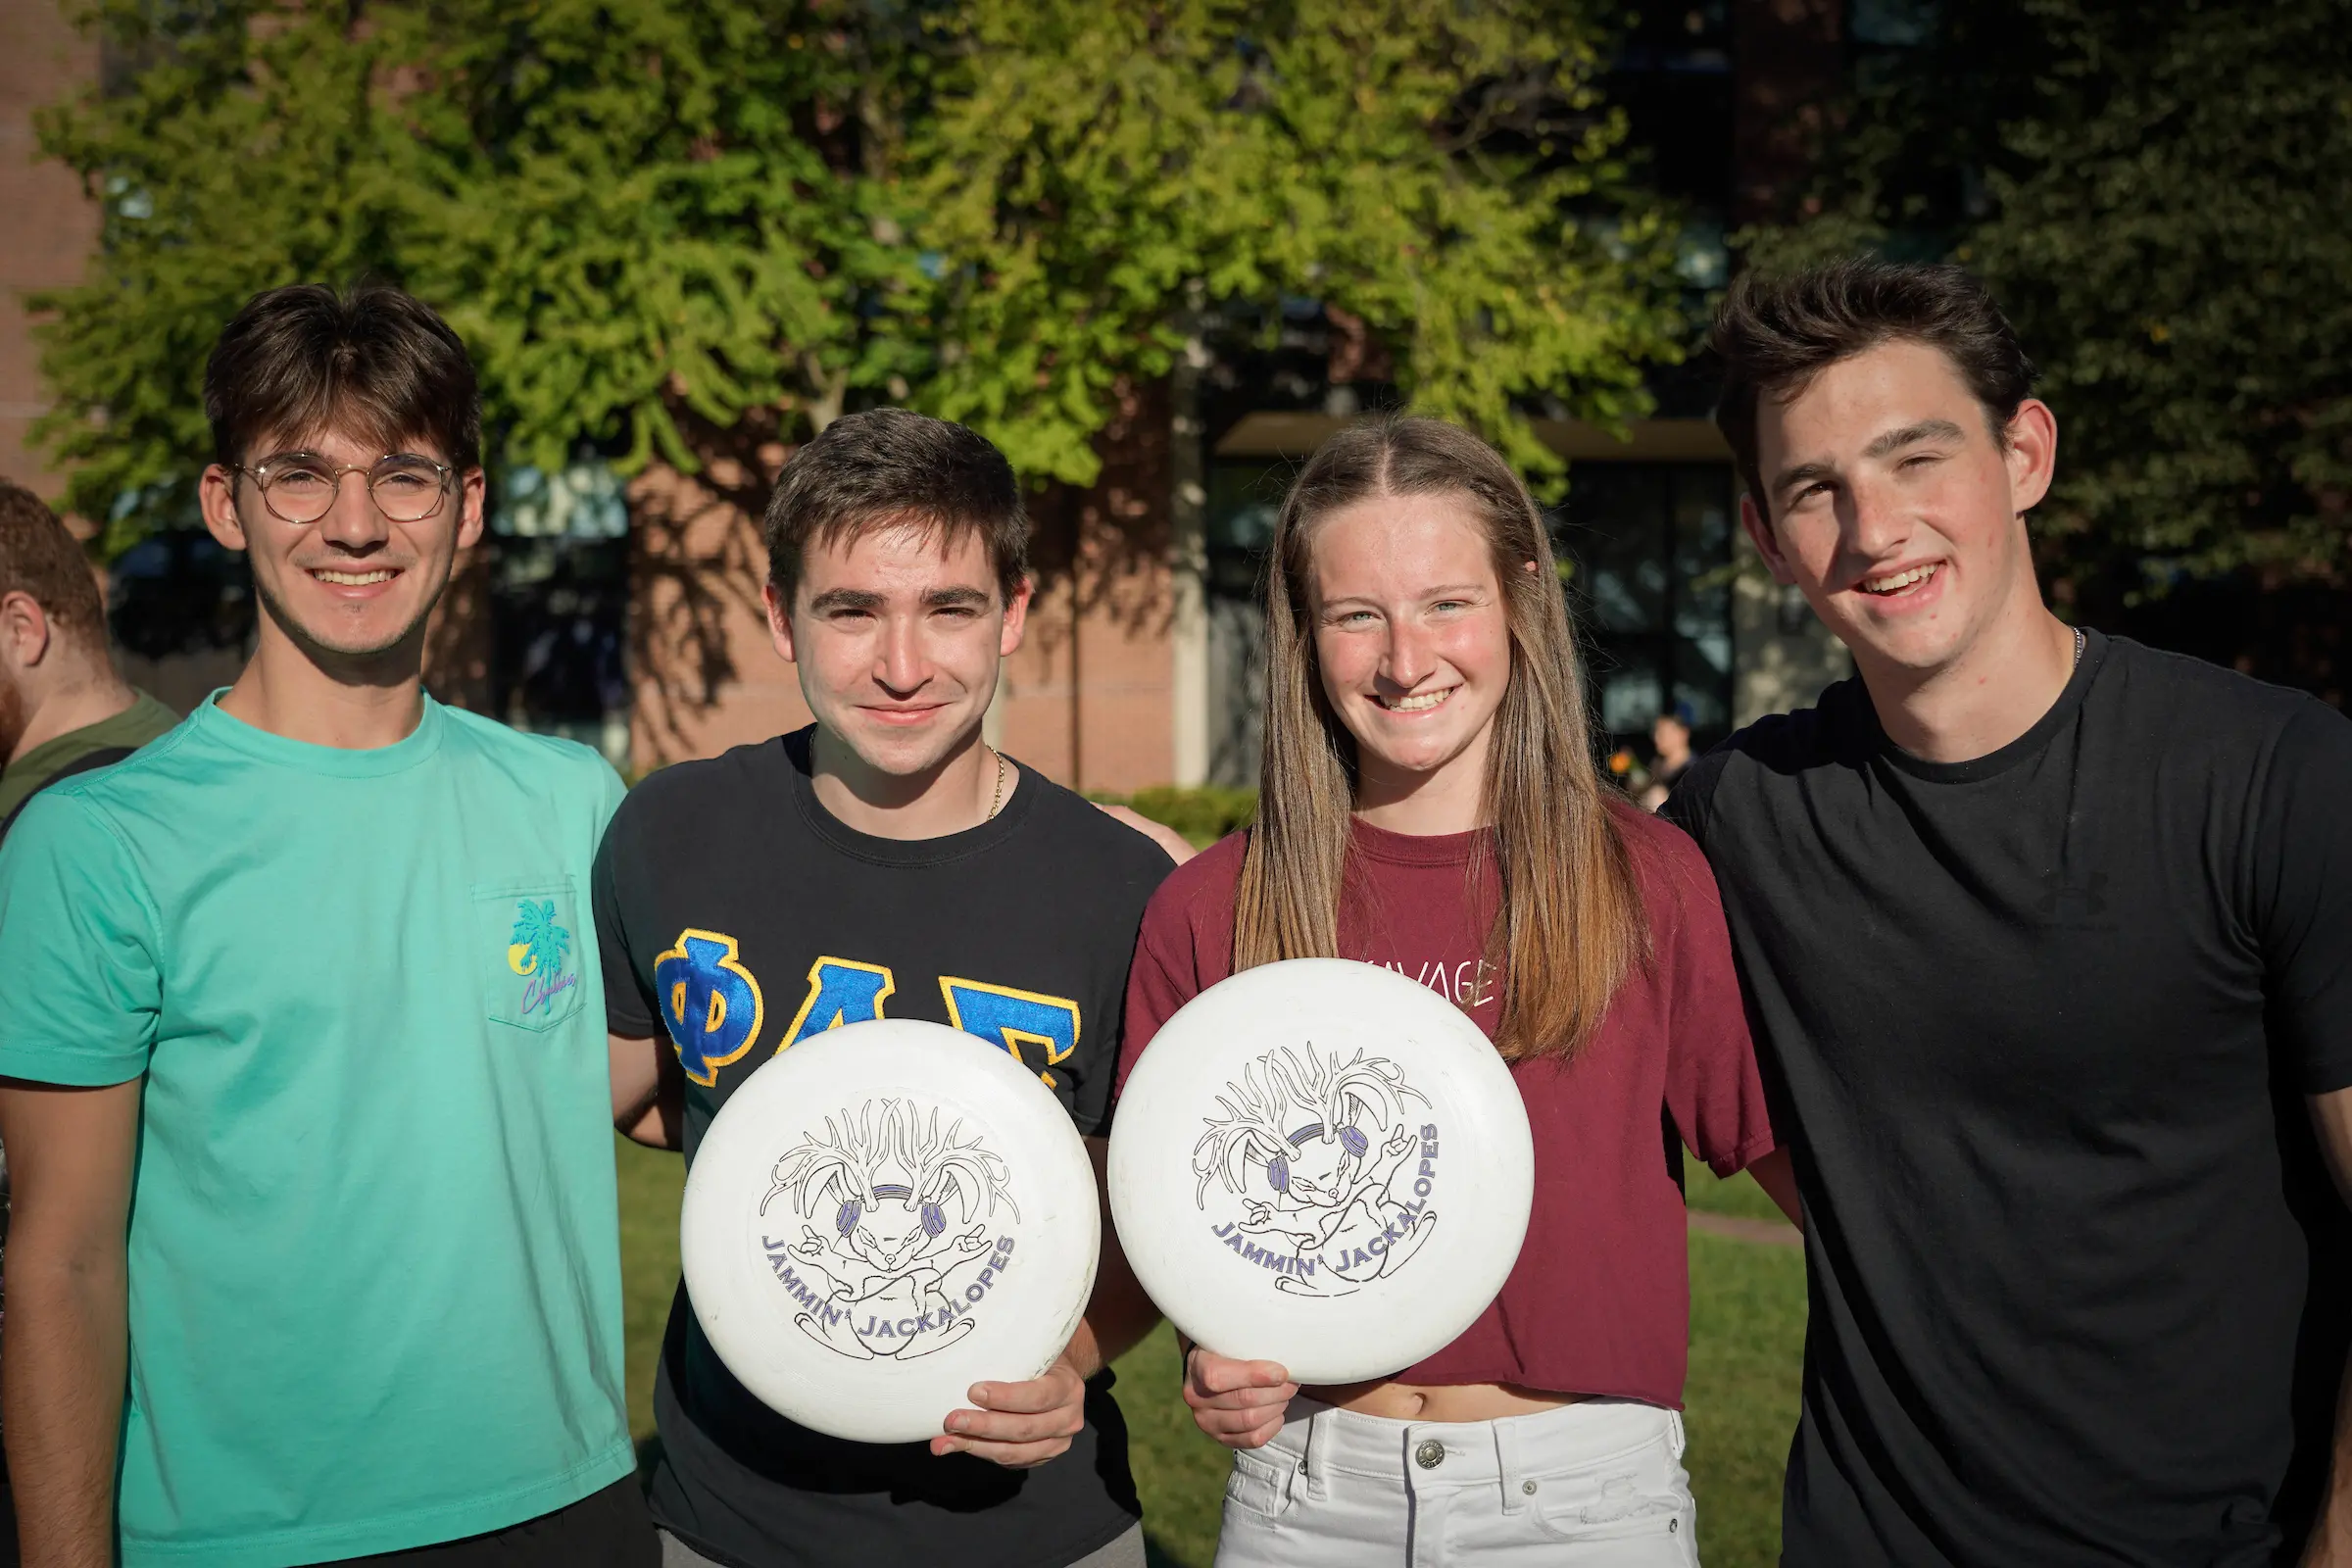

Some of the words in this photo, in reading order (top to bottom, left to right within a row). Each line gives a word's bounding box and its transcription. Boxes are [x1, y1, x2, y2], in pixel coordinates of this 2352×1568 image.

[1367, 959, 1497, 1007] AGE
[1211, 1222, 1324, 1276] JAMMIN'
[1336, 1123, 1439, 1273] JACKALOPES
[761, 1235, 852, 1327] JAMMIN'
[858, 1234, 1015, 1338] JACKALOPES
